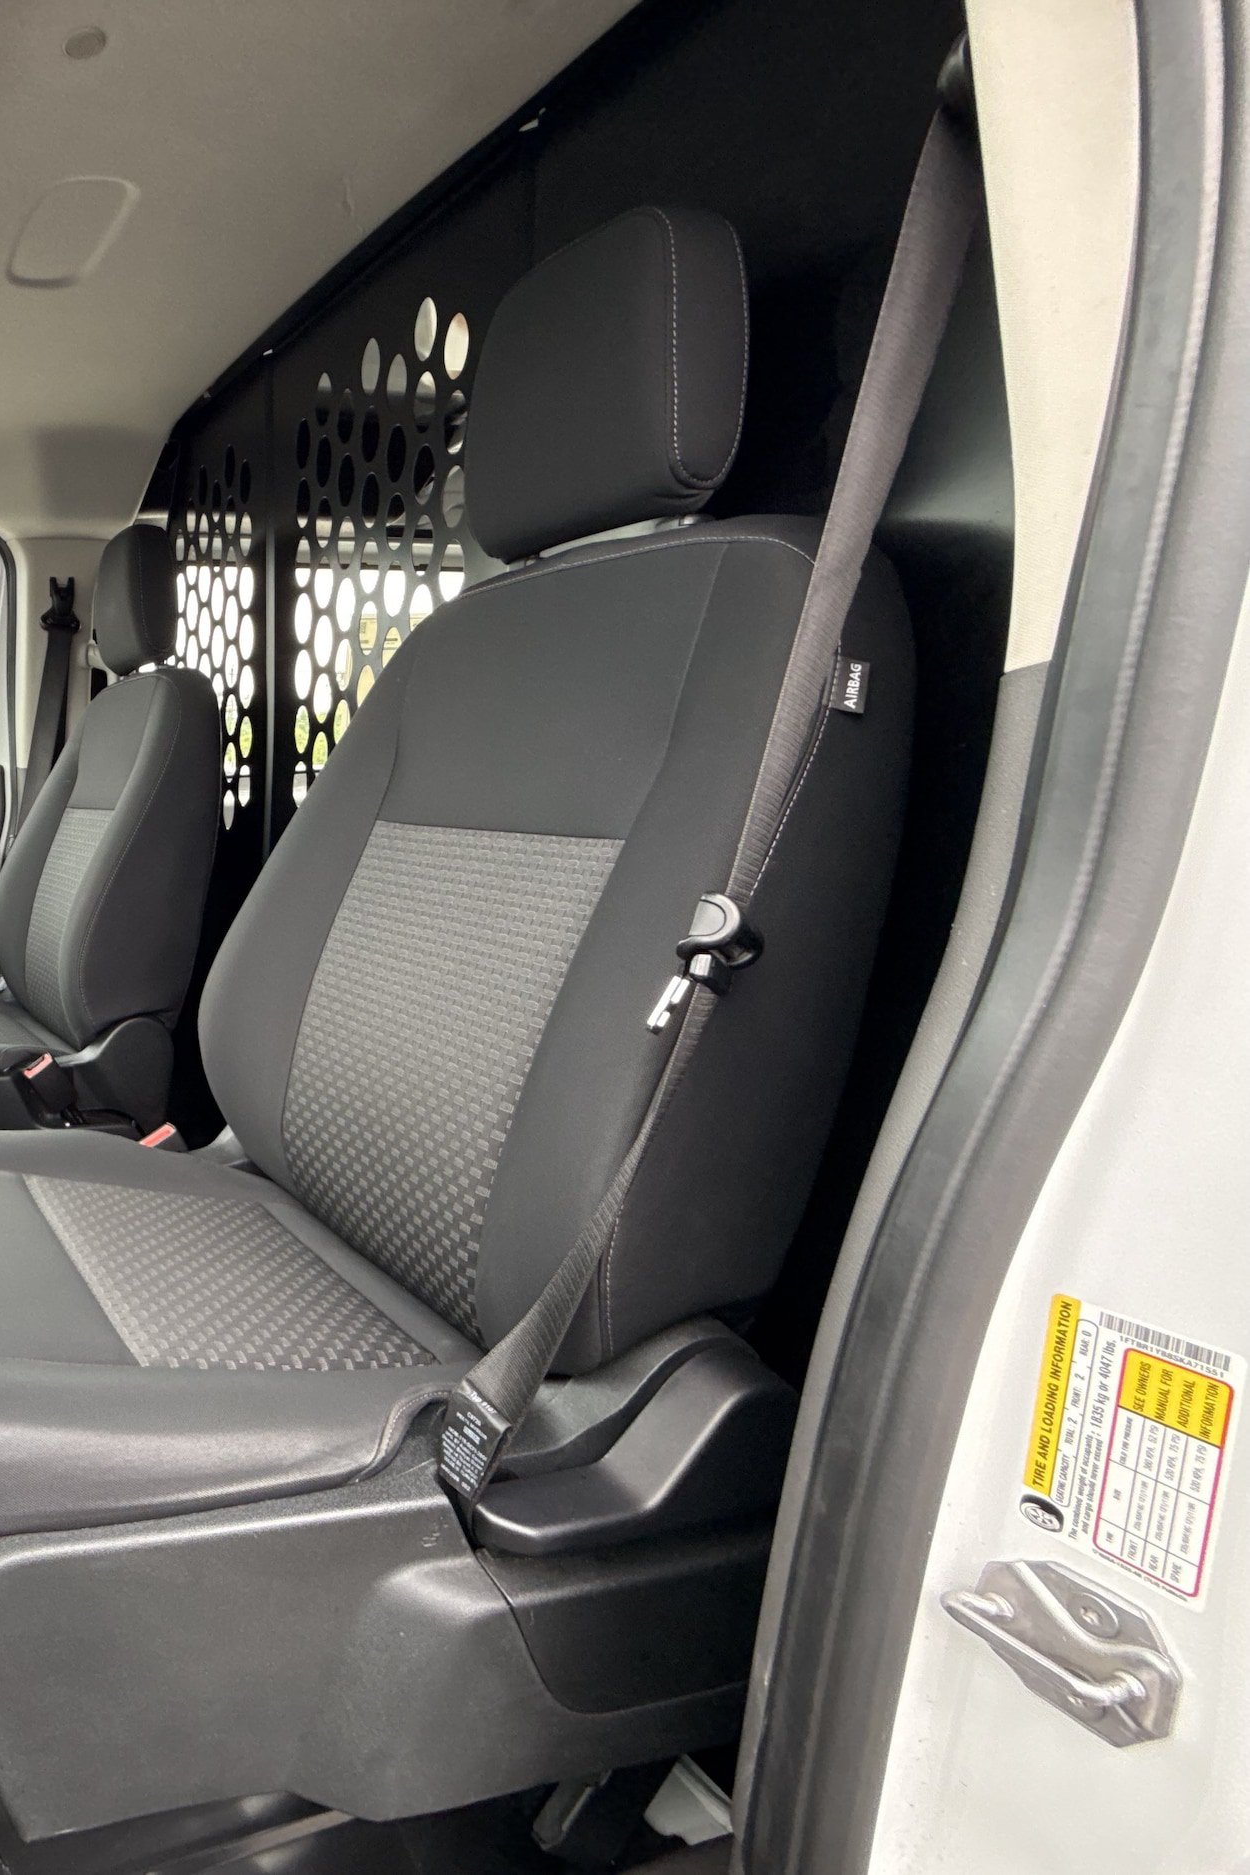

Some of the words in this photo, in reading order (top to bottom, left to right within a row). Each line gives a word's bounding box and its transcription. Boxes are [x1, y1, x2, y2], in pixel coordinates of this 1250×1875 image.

[843, 662, 863, 709] AIRBAG
[1048, 1300, 1073, 1380] INFORMATION
[1102, 1336, 1116, 1356] lbs.
[1097, 1354, 1112, 1380] 4047
[1134, 1360, 1151, 1396] OWNERS
[1159, 1367, 1173, 1386] FOR
[1093, 1390, 1109, 1406] kg
[1098, 1380, 1108, 1392] or
[1039, 1381, 1059, 1434] LOADING
[1132, 1394, 1145, 1412] SEE
[1153, 1385, 1170, 1422] MANUAL
[1175, 1377, 1195, 1428] ADDITIONAL
[1198, 1381, 1219, 1440] INFORMATION
[1058, 1453, 1070, 1481] CAPACITY
[1066, 1415, 1077, 1425] 2
[1073, 1372, 1085, 1381] 2
[1089, 1403, 1104, 1429] 1835
[1036, 1432, 1050, 1460] AND
[1080, 1433, 1094, 1467] occupants
[1092, 1438, 1103, 1462] exceed
[1031, 1458, 1046, 1489] TIRE
[1079, 1465, 1087, 1475] of
[1090, 1461, 1099, 1481] never
[1075, 1474, 1088, 1498] weight
[1085, 1479, 1096, 1502] should
[1070, 1495, 1083, 1528] combined
[1083, 1501, 1094, 1522] cargo
[1068, 1526, 1077, 1539] The
[1080, 1520, 1089, 1534] and
